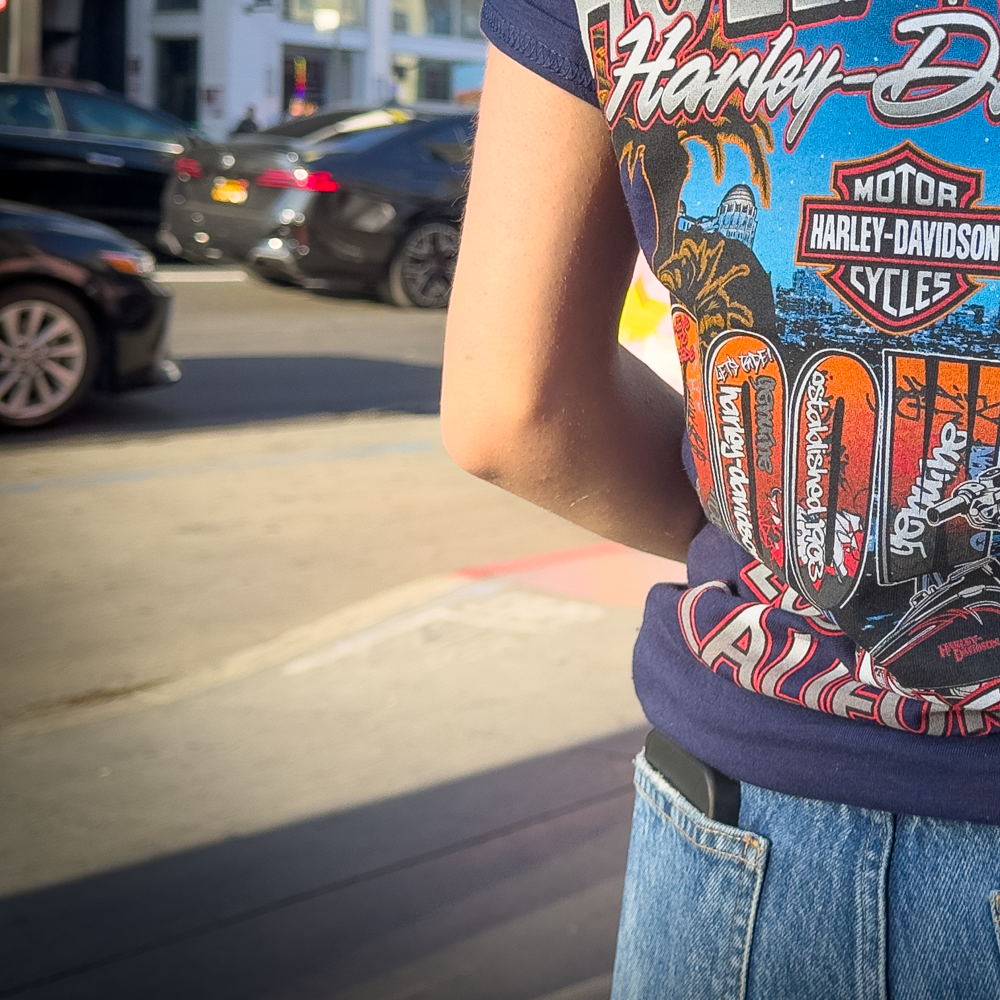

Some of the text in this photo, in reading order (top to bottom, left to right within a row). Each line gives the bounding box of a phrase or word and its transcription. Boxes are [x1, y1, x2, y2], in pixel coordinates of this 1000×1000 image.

[853, 162, 958, 208] MOTOR
[809, 213, 1000, 262] HARLEY-DAVIDSON
[850, 265, 951, 317] CYCLES
[716, 384, 762, 562] harley-davidso
[803, 369, 829, 583] established 1903
[890, 421, 968, 559] genuine
